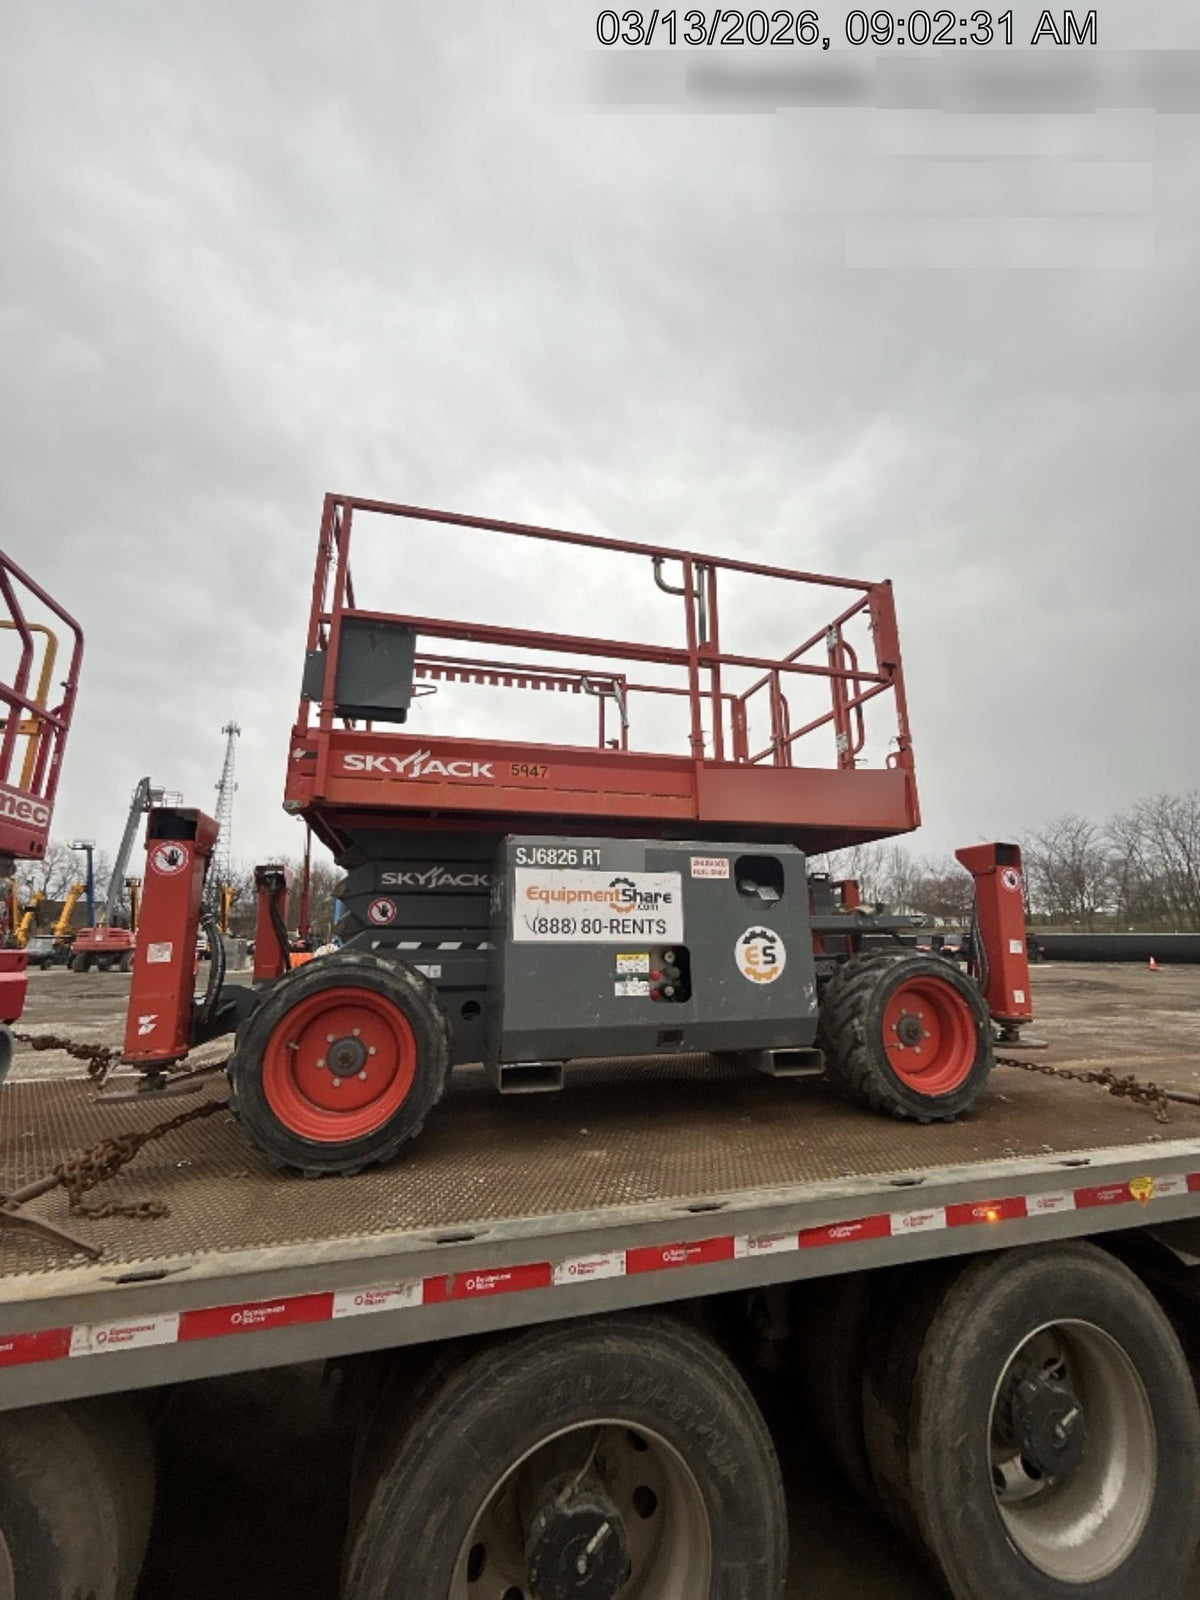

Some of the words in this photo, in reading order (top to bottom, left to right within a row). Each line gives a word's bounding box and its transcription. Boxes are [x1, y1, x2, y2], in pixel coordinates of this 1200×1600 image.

[343, 749, 494, 778] SKYJACK
[511, 764, 549, 778] 5947
[515, 847, 578, 865] SJ6826
[381, 866, 490, 889] SKYJACK
[532, 917, 577, 936] (888)
[580, 918, 667, 936] 80-RENTS
